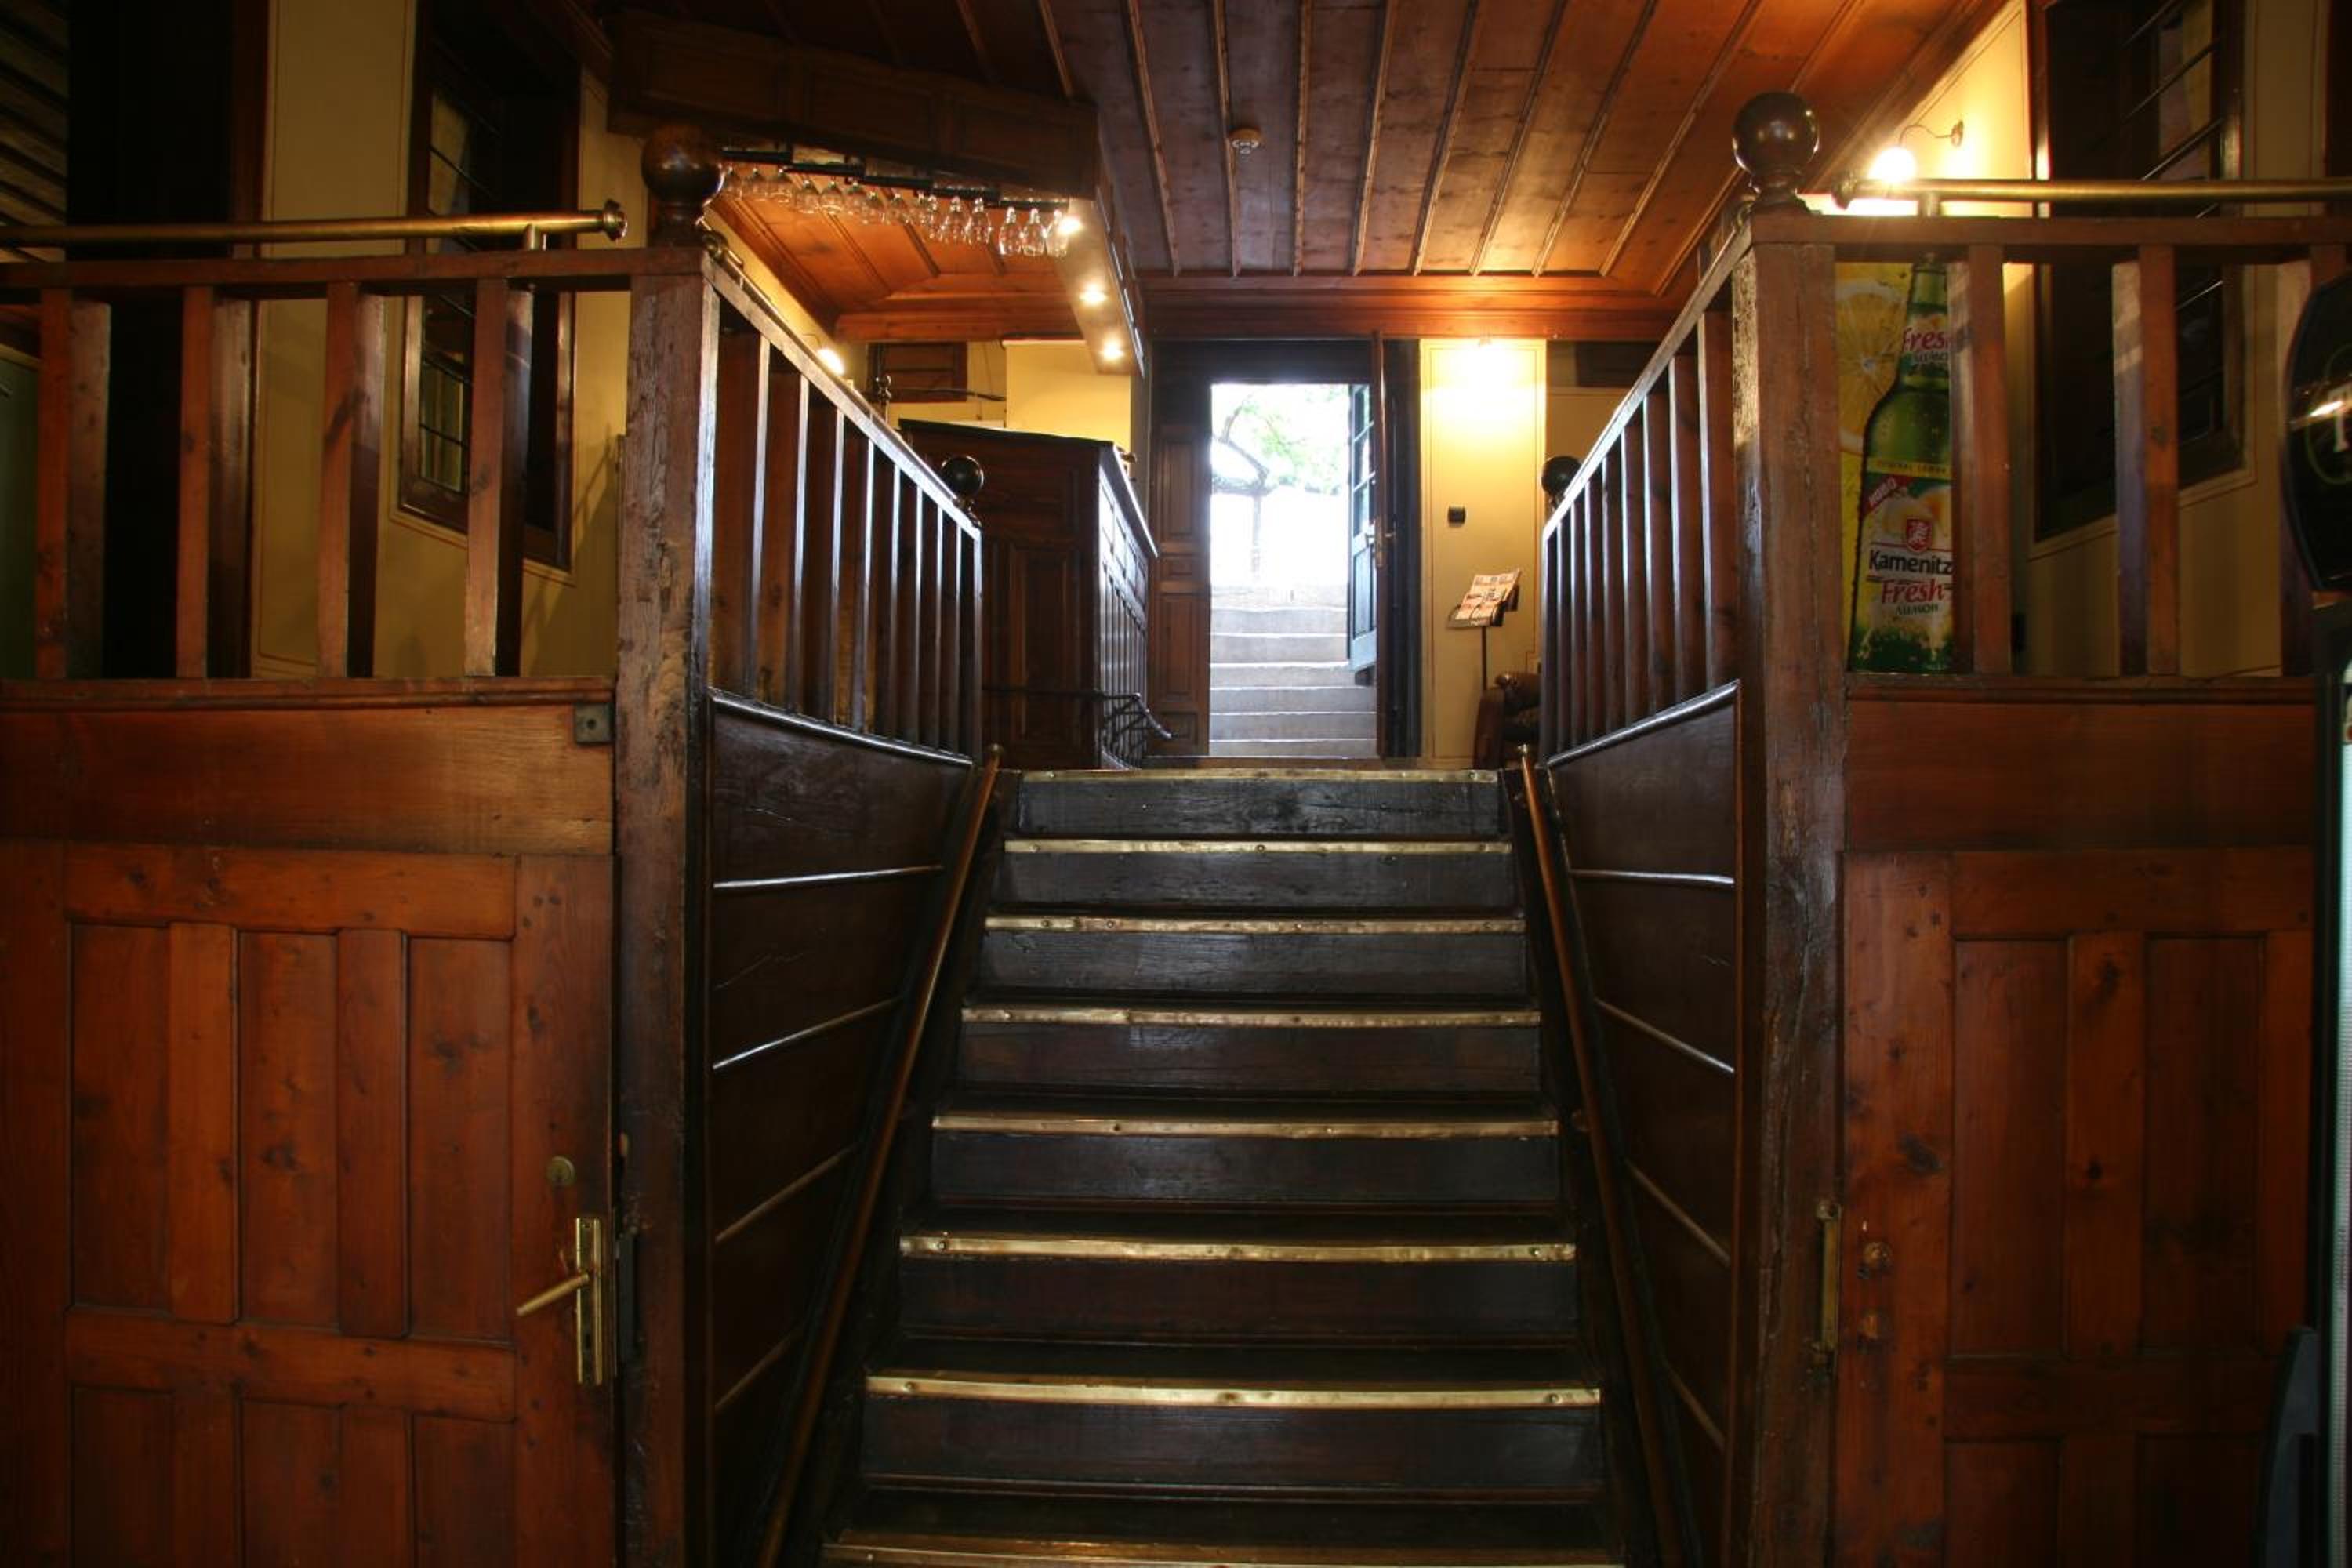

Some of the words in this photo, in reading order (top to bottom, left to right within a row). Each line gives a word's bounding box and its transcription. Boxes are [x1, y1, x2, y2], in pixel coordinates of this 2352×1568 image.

[1903, 327, 1948, 351] Fres
[1869, 550, 1955, 575] Kamenitz
[1882, 578, 1944, 603] Fresh
